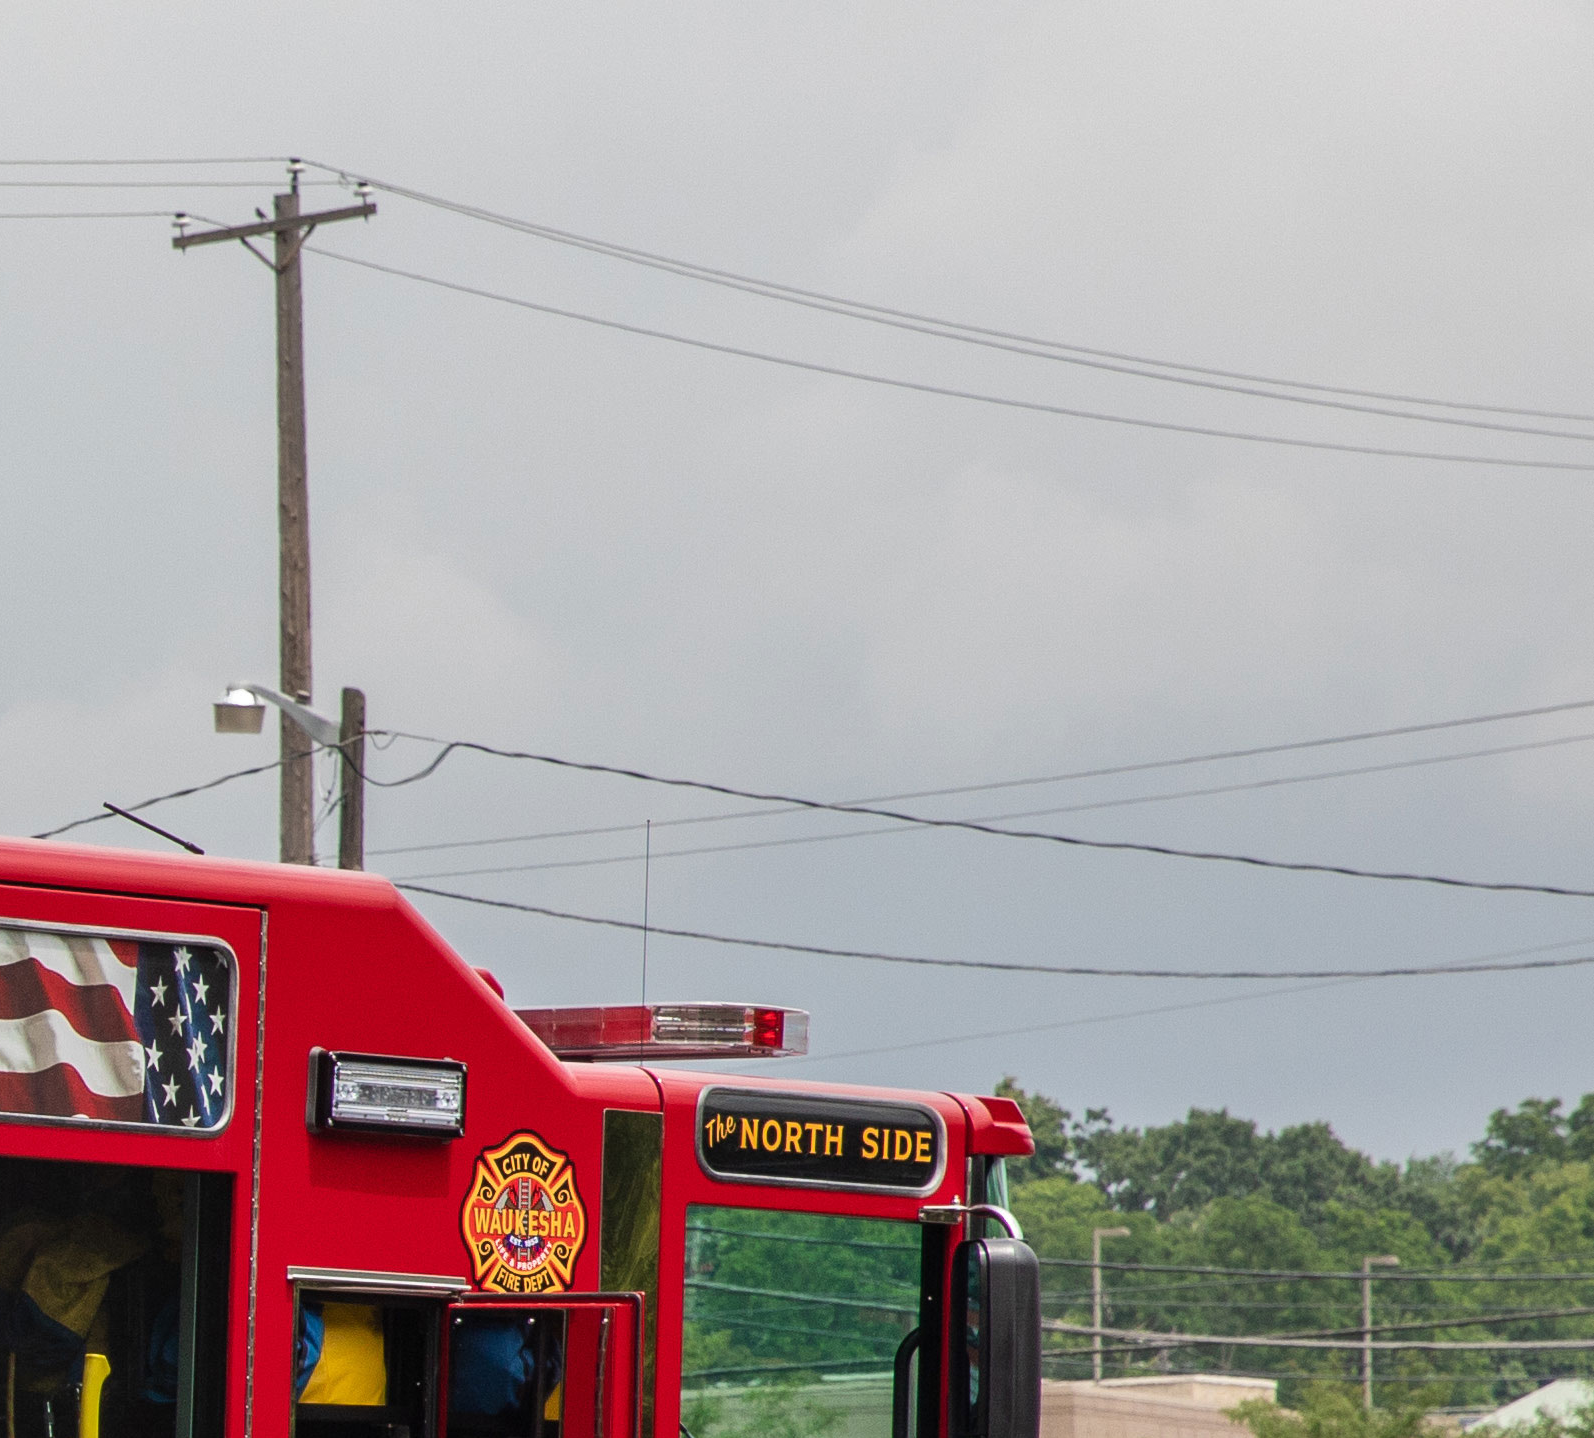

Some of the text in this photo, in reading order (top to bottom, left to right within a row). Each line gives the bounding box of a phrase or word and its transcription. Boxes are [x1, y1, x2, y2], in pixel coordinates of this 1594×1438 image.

[705, 1113, 932, 1163] The NORTH SIDE
[502, 1153, 550, 1175] CITY OF
[474, 1207, 576, 1238] WAUKESHA
[494, 1238, 510, 1261] LIFE
[516, 1241, 553, 1270] PROPERTY
[496, 1267, 550, 1292] FIRE DEPT
